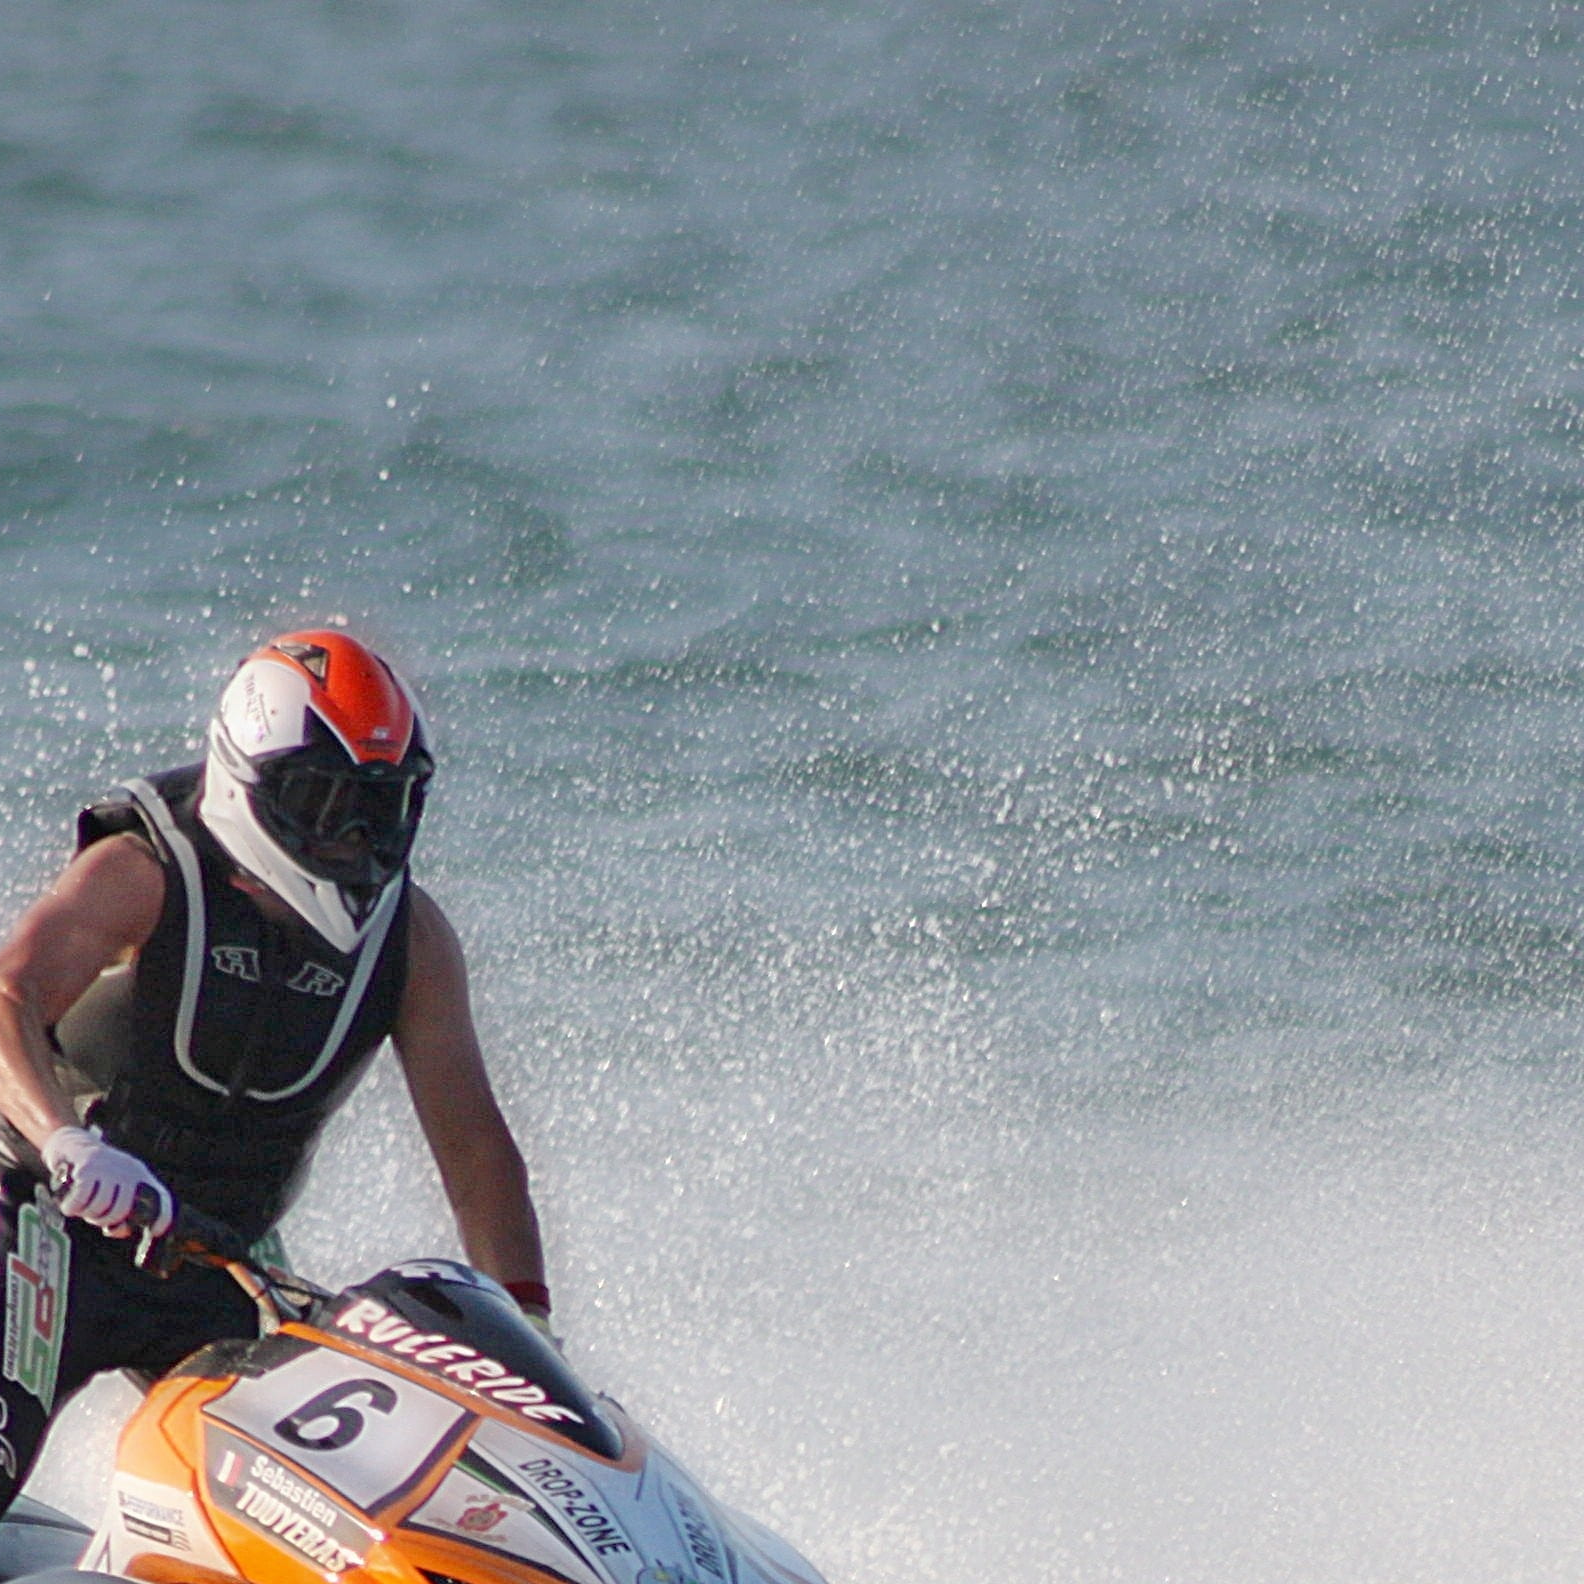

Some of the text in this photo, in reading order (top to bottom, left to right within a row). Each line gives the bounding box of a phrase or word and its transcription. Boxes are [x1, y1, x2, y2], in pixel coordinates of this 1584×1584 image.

[273, 1377, 399, 1452] 6
[250, 1454, 338, 1528] Sebastien
[517, 1458, 631, 1558] DROP-ZONE
